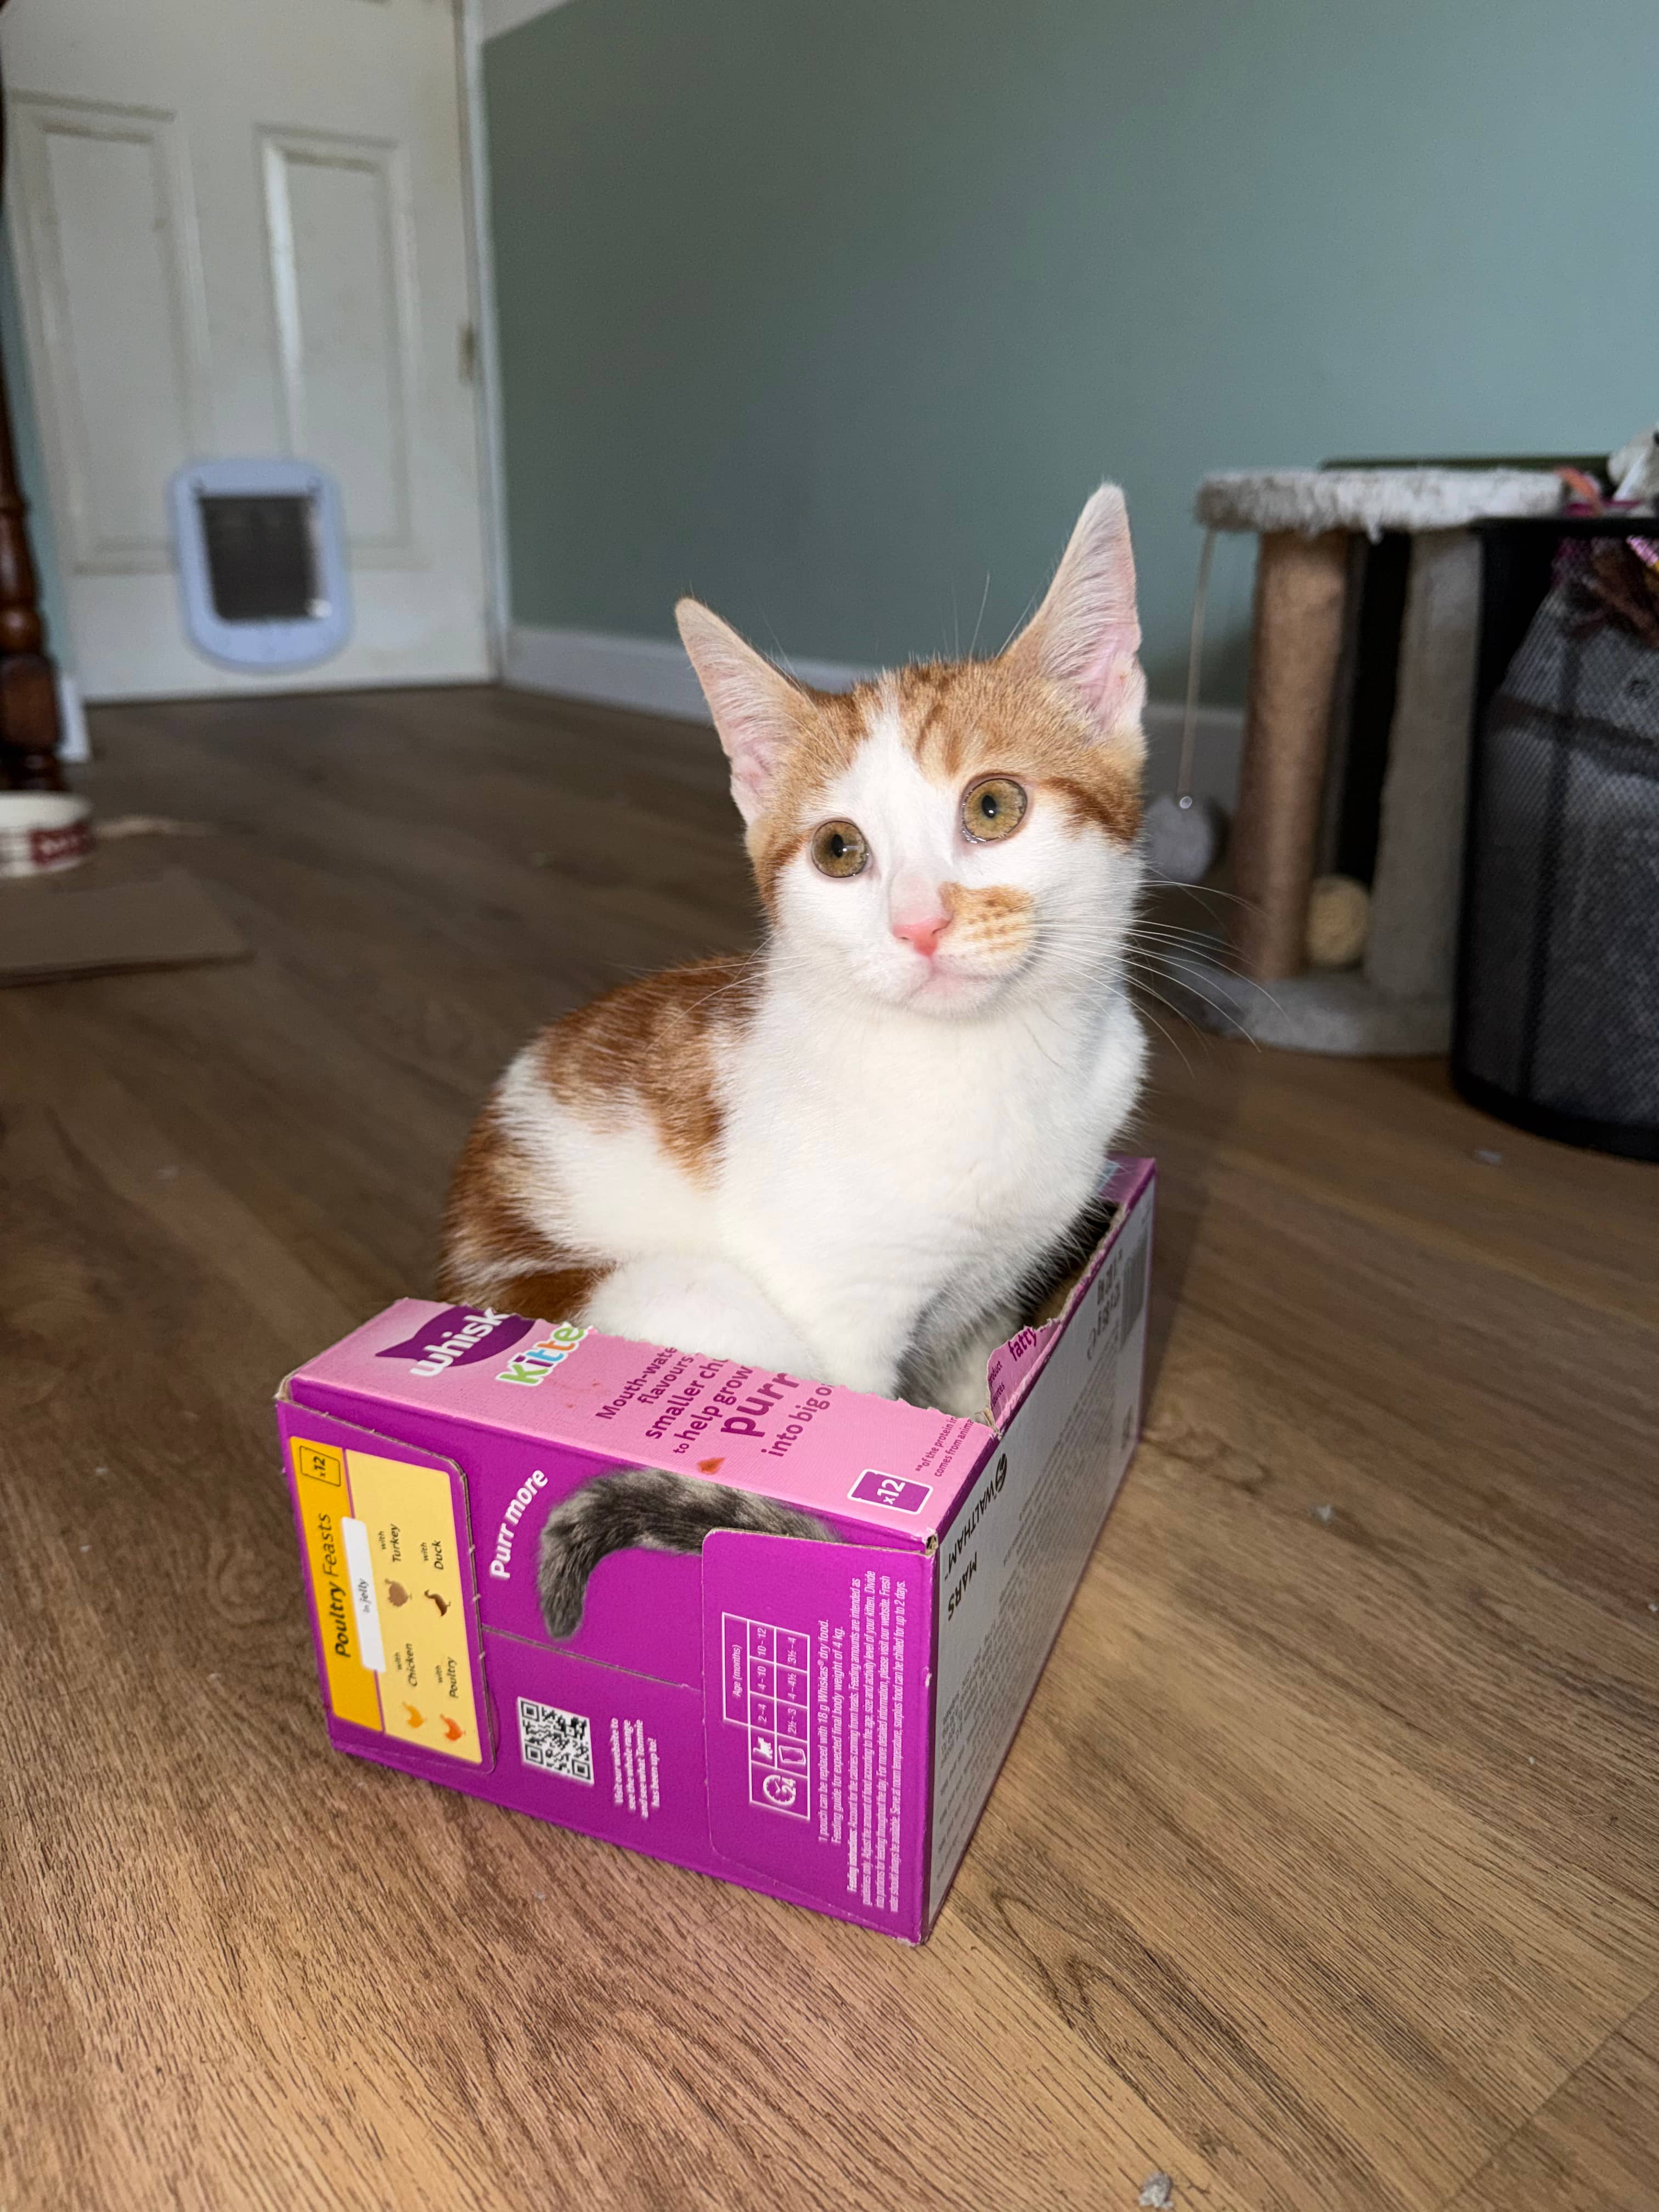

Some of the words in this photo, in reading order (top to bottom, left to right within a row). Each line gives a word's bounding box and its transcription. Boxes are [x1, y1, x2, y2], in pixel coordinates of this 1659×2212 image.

[1008, 1328, 1036, 1362] fatty
[637, 1356, 694, 1404] flavours
[713, 1365, 753, 1406] grow
[645, 1380, 706, 1440] smaller
[720, 1372, 800, 1437] purr
[673, 1405, 723, 1441] help
[761, 1424, 803, 1457] into
[788, 1397, 830, 1422] big
[673, 1442, 690, 1454] to
[925, 1447, 939, 1458] the
[934, 1423, 954, 1448] protein
[313, 1455, 327, 1477] x12
[934, 1455, 952, 1477] comes
[945, 1439, 963, 1455] from
[877, 1479, 906, 1505] x12
[490, 1522, 515, 1579] Purr
[505, 1470, 549, 1525] more
[318, 1513, 340, 1577] Feasts
[378, 1531, 387, 1550] with
[390, 1523, 402, 1562] Turkey
[420, 1542, 429, 1561] with
[431, 1540, 444, 1570] Duck
[358, 1578, 372, 1605] jelly
[851, 1578, 861, 1587] as
[865, 1570, 876, 1594] Divide
[879, 1575, 890, 1596] Fresh
[894, 1580, 908, 1599] days.
[948, 1550, 977, 1622] MARS
[850, 1587, 860, 1618] intended
[865, 1595, 875, 1616] kitten.
[879, 1598, 890, 1626] website.
[894, 1606, 905, 1615] to
[329, 1581, 351, 1658] Poultry
[818, 1620, 828, 1641] food.
[851, 1619, 860, 1632] are
[866, 1616, 877, 1633] your
[896, 1615, 907, 1626] up
[832, 1626, 845, 1640] kg.
[864, 1633, 874, 1642] of
[881, 1626, 889, 1640] our
[894, 1626, 905, 1638] for
[818, 1643, 831, 1658] dry
[832, 1649, 843, 1660] of
[850, 1632, 860, 1663] amounts
[864, 1642, 874, 1660] level
[879, 1640, 889, 1655] visit
[893, 1637, 904, 1661] chilled
[404, 1643, 417, 1687] Chicken
[732, 1644, 743, 1680] (months)
[864, 1661, 877, 1684] activity
[878, 1656, 890, 1679] please
[893, 1661, 904, 1671] be
[446, 1657, 459, 1699] Poultry
[832, 1661, 845, 1690] weight
[848, 1663, 861, 1690] Feeding
[895, 1671, 904, 1684] can
[732, 1681, 743, 1697] Age
[864, 1684, 873, 1699] and
[878, 1680, 890, 1720] information,
[893, 1684, 904, 1701] food
[832, 1691, 844, 1714] body
[849, 1691, 860, 1712] treats.
[863, 1700, 873, 1713] size
[611, 1718, 619, 1729] to
[817, 1711, 828, 1723] 18
[832, 1716, 842, 1734] final
[848, 1712, 859, 1729] from
[893, 1702, 905, 1728] surplus
[623, 1719, 634, 1747] range
[818, 1725, 828, 1743] with
[848, 1730, 860, 1755] coming
[863, 1728, 873, 1739] the
[863, 1740, 873, 1748] to
[877, 1720, 888, 1746] detailed
[610, 1729, 621, 1767] website
[650, 1753, 660, 1766] up
[832, 1736, 844, 1773] expected
[879, 1747, 887, 1765] more
[891, 1729, 904, 1769] temperature,
[623, 1747, 634, 1777] whole
[818, 1745, 830, 1781] replaced
[877, 1764, 887, 1778] For
[650, 1766, 659, 1790] been
[781, 1777, 797, 1795] 24
[818, 1781, 828, 1792] be
[832, 1773, 842, 1787] for
[820, 1793, 828, 1809] can
[831, 1788, 844, 1813] guide
[831, 1813, 844, 1843] Feeding
